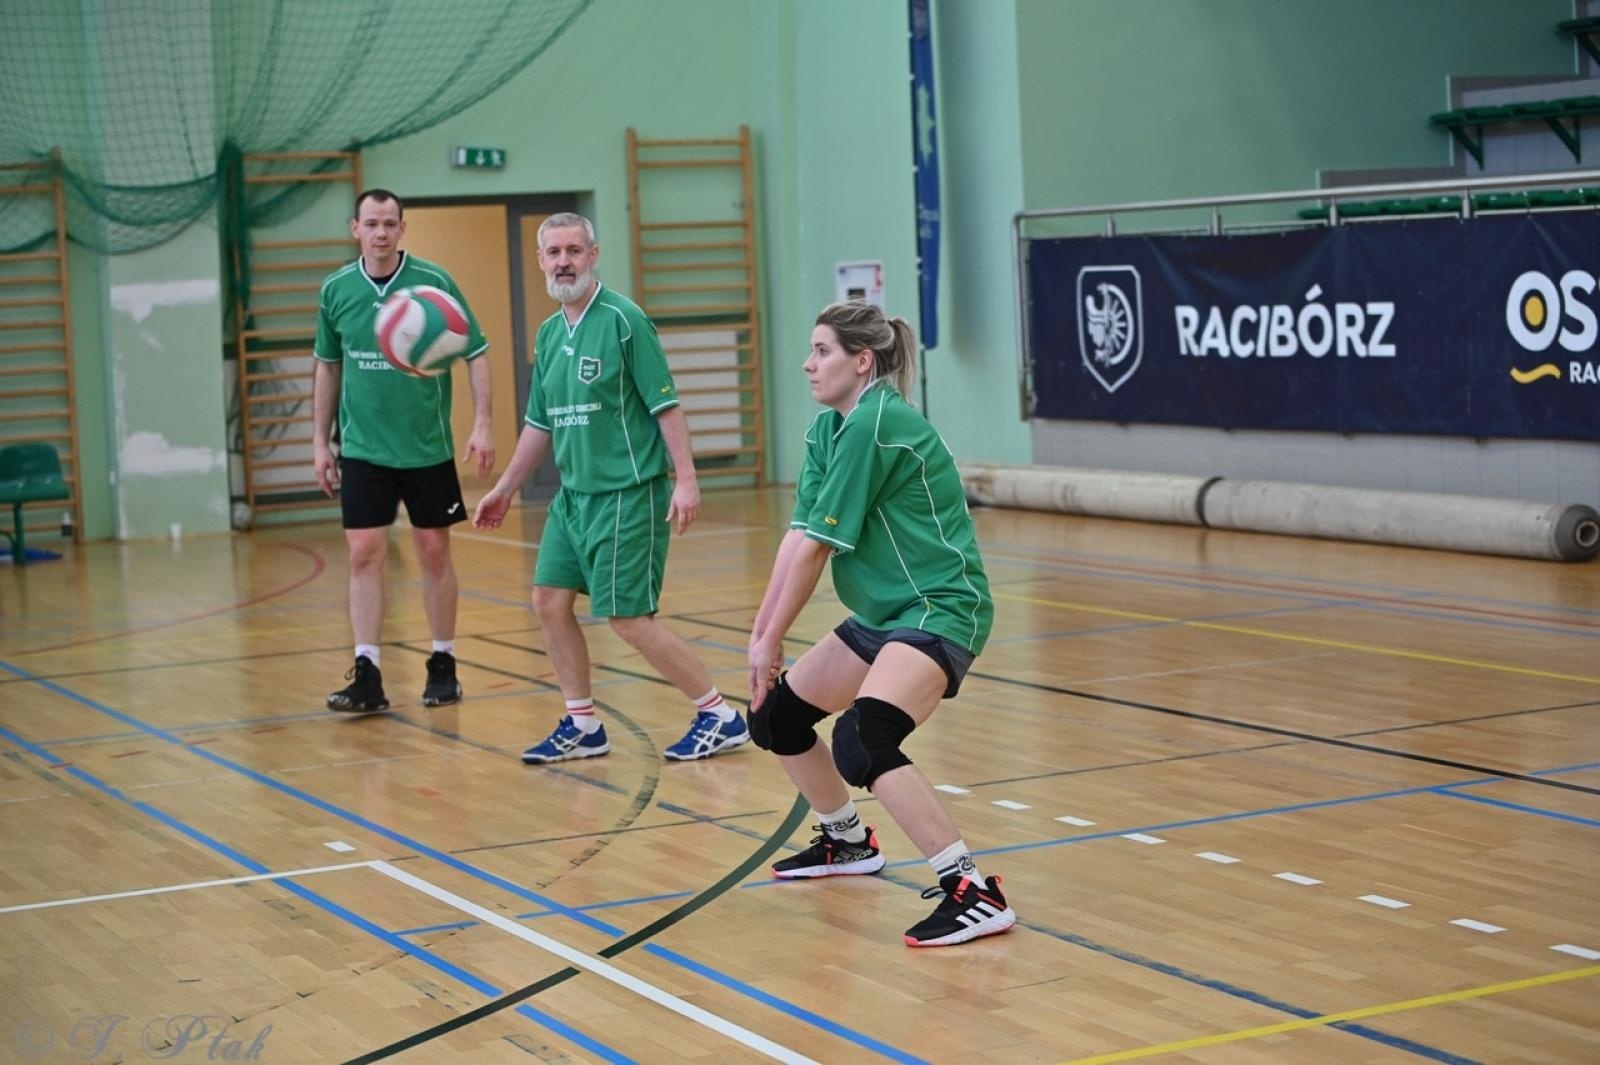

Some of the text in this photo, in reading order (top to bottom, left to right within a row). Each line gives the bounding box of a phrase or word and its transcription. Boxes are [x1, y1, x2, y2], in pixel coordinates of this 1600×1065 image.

[1174, 283, 1397, 358] RACIBÓRZ
[1505, 269, 1600, 353] OS
[1569, 360, 1600, 385] RA
